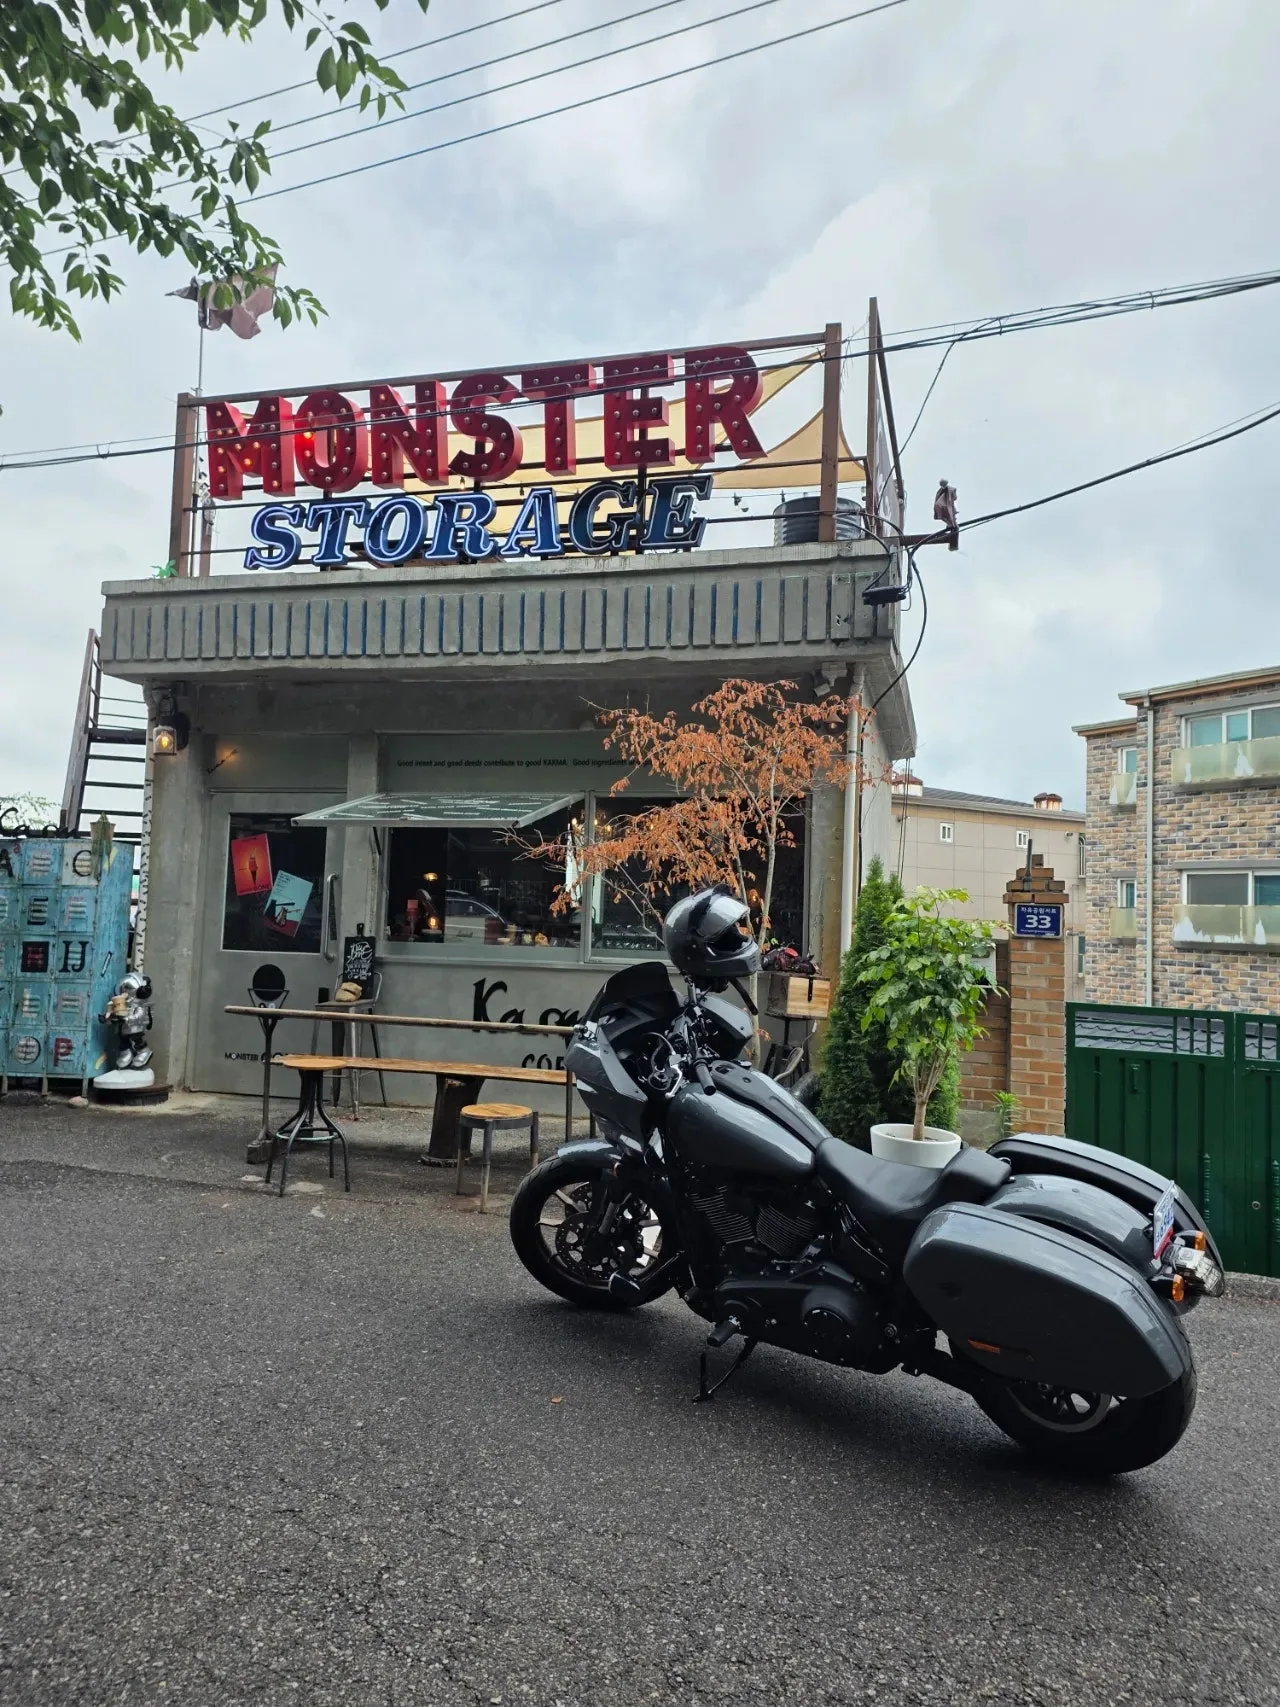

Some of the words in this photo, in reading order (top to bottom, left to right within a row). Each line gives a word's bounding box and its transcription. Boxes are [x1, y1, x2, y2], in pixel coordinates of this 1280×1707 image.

[206, 346, 768, 501] MONSTER
[244, 474, 713, 570] STORAGE
[396, 759, 414, 768] Good
[434, 759, 446, 768] and
[447, 759, 463, 770] good
[464, 759, 482, 768] deeds
[484, 759, 515, 768] contribute
[525, 760, 542, 770] good
[573, 759, 590, 768] Good
[1025, 914, 1052, 929] 33
